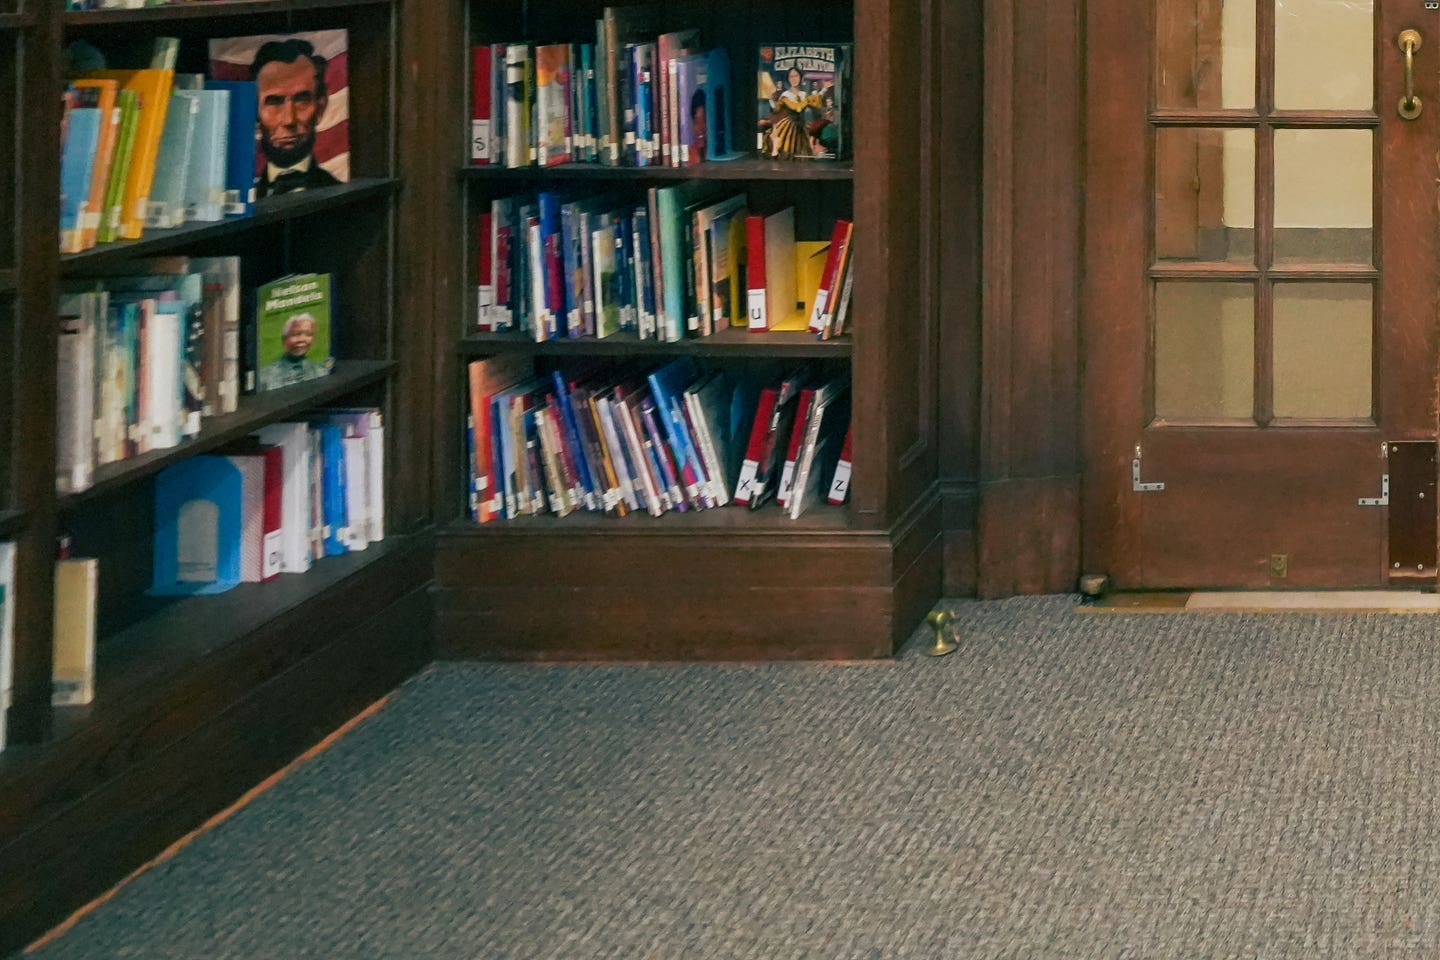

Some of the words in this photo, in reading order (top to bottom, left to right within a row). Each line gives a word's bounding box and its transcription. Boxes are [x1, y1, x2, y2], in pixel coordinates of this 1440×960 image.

[474, 136, 485, 150] S
[265, 292, 323, 311] Mandela
[750, 307, 761, 320] U
[834, 480, 844, 492] Z
